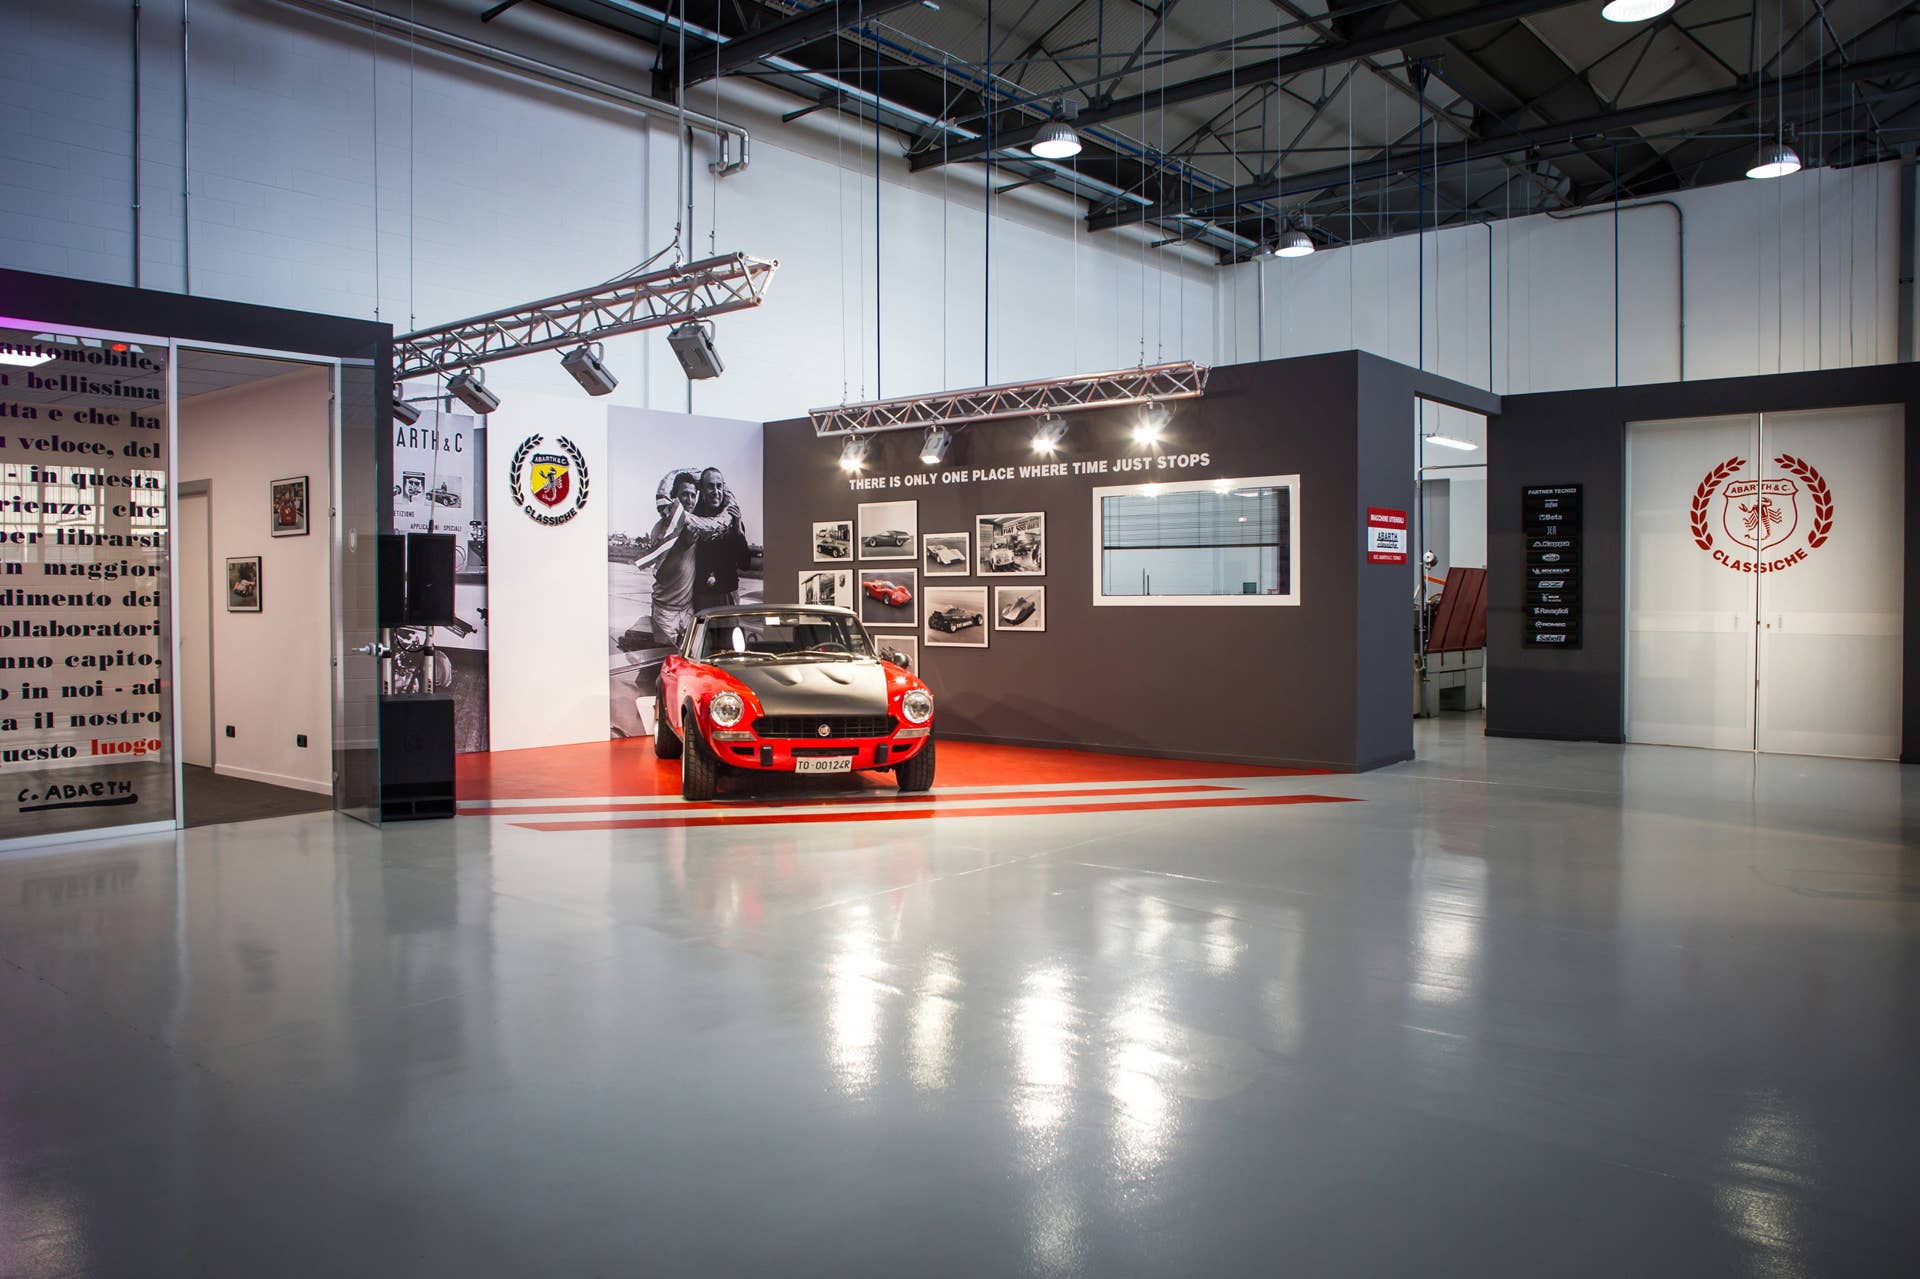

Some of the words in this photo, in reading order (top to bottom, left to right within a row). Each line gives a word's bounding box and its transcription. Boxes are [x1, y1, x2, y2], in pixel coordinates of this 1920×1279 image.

[27, 371, 160, 400] bellissima
[48, 409, 63, 422] e
[74, 408, 120, 426] che
[130, 411, 161, 429] ha
[18, 435, 115, 459] veloce,
[123, 441, 160, 458] del
[443, 438, 451, 452] &
[30, 466, 57, 483] in
[71, 470, 159, 490] questa
[849, 477, 886, 490] THERE
[889, 476, 901, 488] IS
[904, 473, 938, 487] ONLY
[942, 470, 969, 484] ONE
[972, 467, 1015, 481] PLACE
[1019, 463, 1068, 479] WHERE
[1072, 460, 1108, 475] TIME
[1112, 457, 1152, 472] JUST
[1157, 453, 1211, 469] STOPS
[1773, 484, 1780, 492] &
[113, 502, 160, 518] che
[525, 505, 578, 525] CLASSICHE
[56, 528, 160, 547] librarsi
[44, 560, 161, 580] maggior
[1712, 548, 1809, 574] CLASSICHE
[122, 591, 160, 606] dei
[65, 650, 162, 671] capito,
[22, 682, 48, 699] in
[62, 680, 103, 698] noi
[132, 679, 161, 695] ad
[34, 712, 54, 729] il
[70, 709, 162, 727] nostro
[91, 738, 161, 756] luogo
